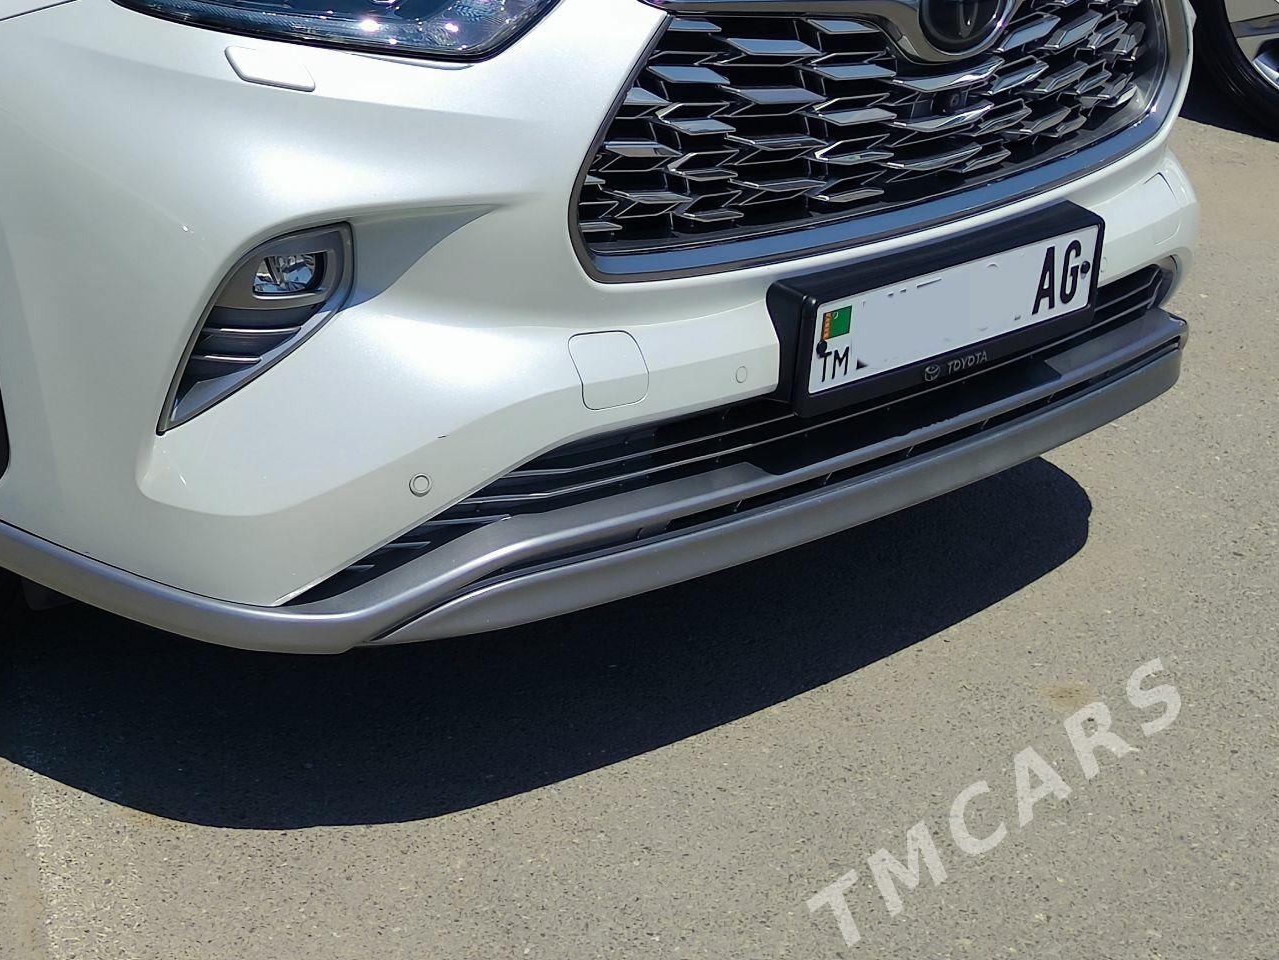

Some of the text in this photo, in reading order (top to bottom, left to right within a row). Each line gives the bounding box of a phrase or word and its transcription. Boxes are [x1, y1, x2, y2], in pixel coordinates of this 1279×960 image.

[1032, 239, 1083, 315] AG
[820, 347, 850, 383] TM
[946, 350, 988, 375] TOYOTA
